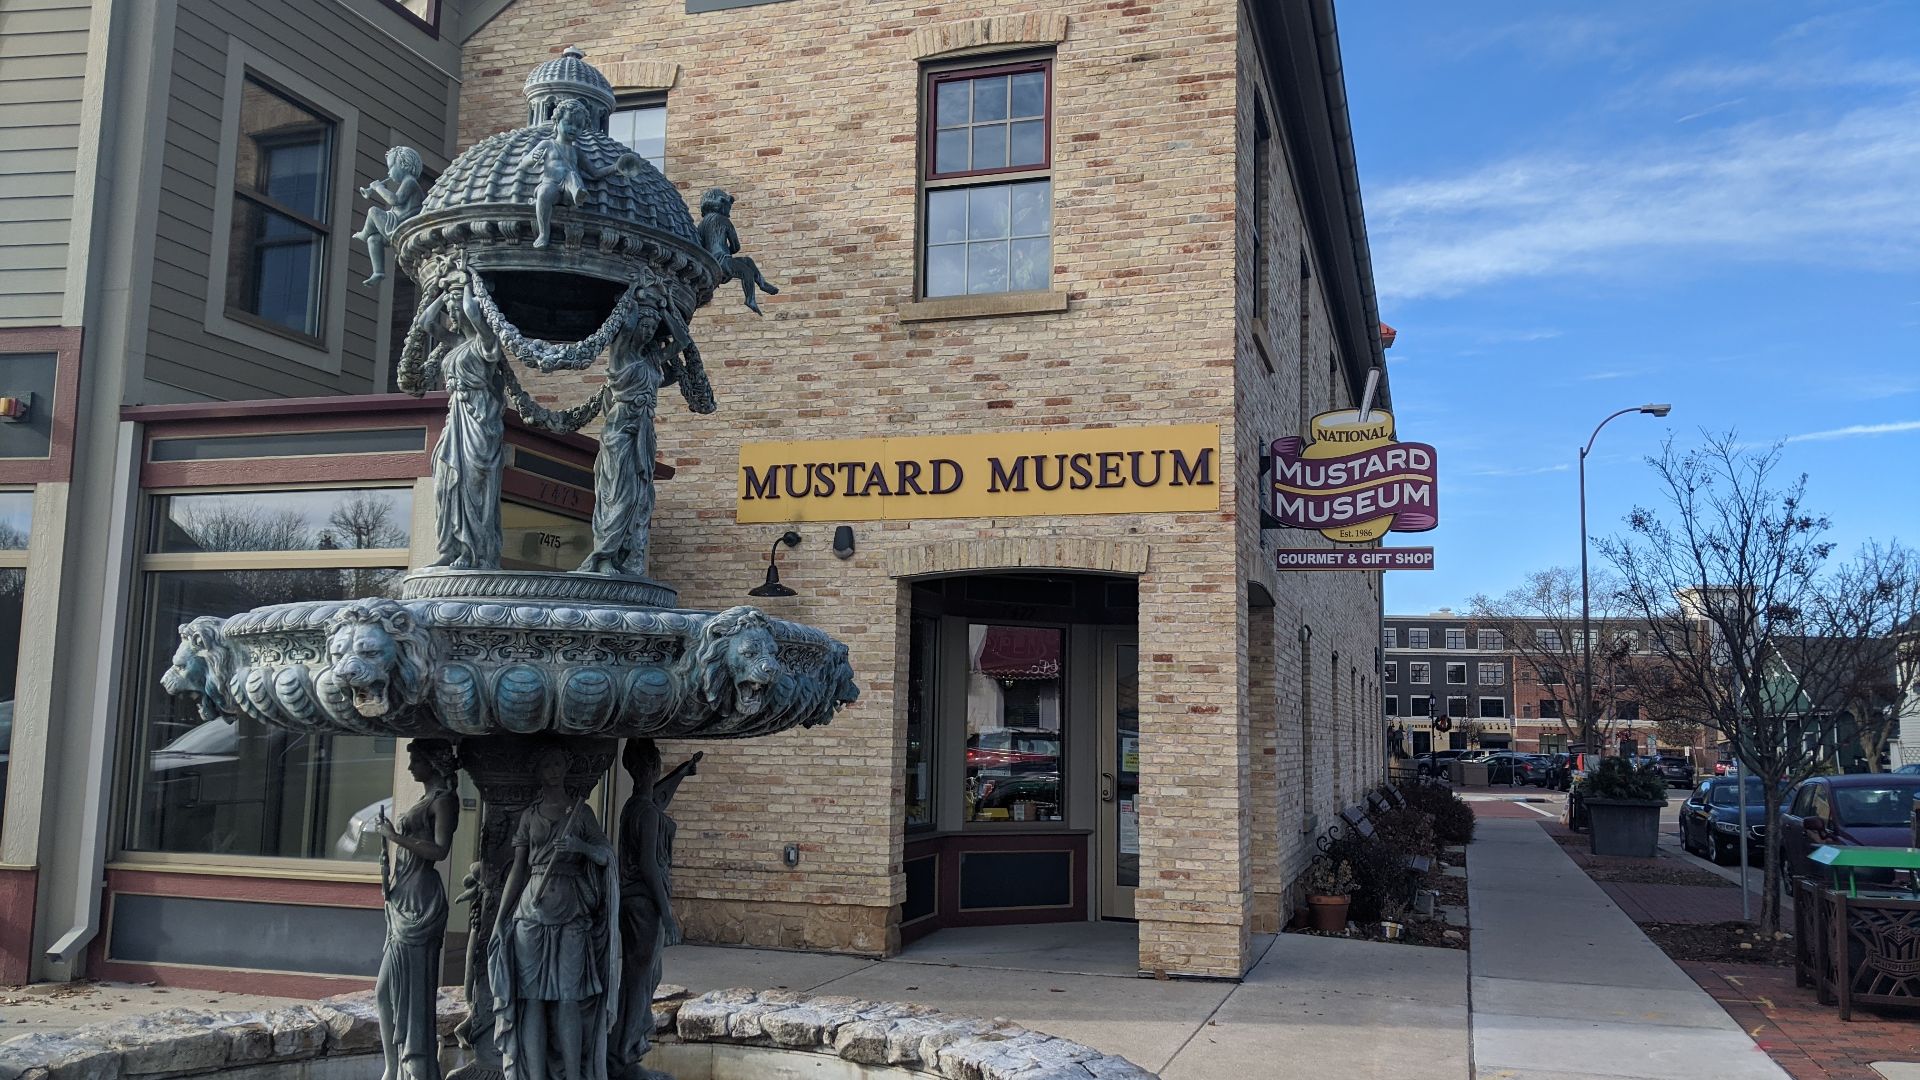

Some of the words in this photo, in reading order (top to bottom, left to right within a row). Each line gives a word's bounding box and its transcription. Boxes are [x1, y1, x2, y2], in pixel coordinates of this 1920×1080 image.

[1317, 426, 1388, 443] NATIONAL
[741, 458, 965, 500] MUSTARD
[987, 447, 1215, 493] MUSEUM
[1275, 448, 1431, 487] MUSTARD
[1276, 482, 1431, 523] MUSEUM
[539, 532, 561, 548] 7475
[1339, 530, 1354, 538] Est.
[1355, 529, 1373, 538] 1986
[1278, 553, 1344, 565] GOURMET
[1347, 553, 1358, 565] &
[1361, 553, 1392, 565] GIFT
[1395, 553, 1433, 565] SHOP
